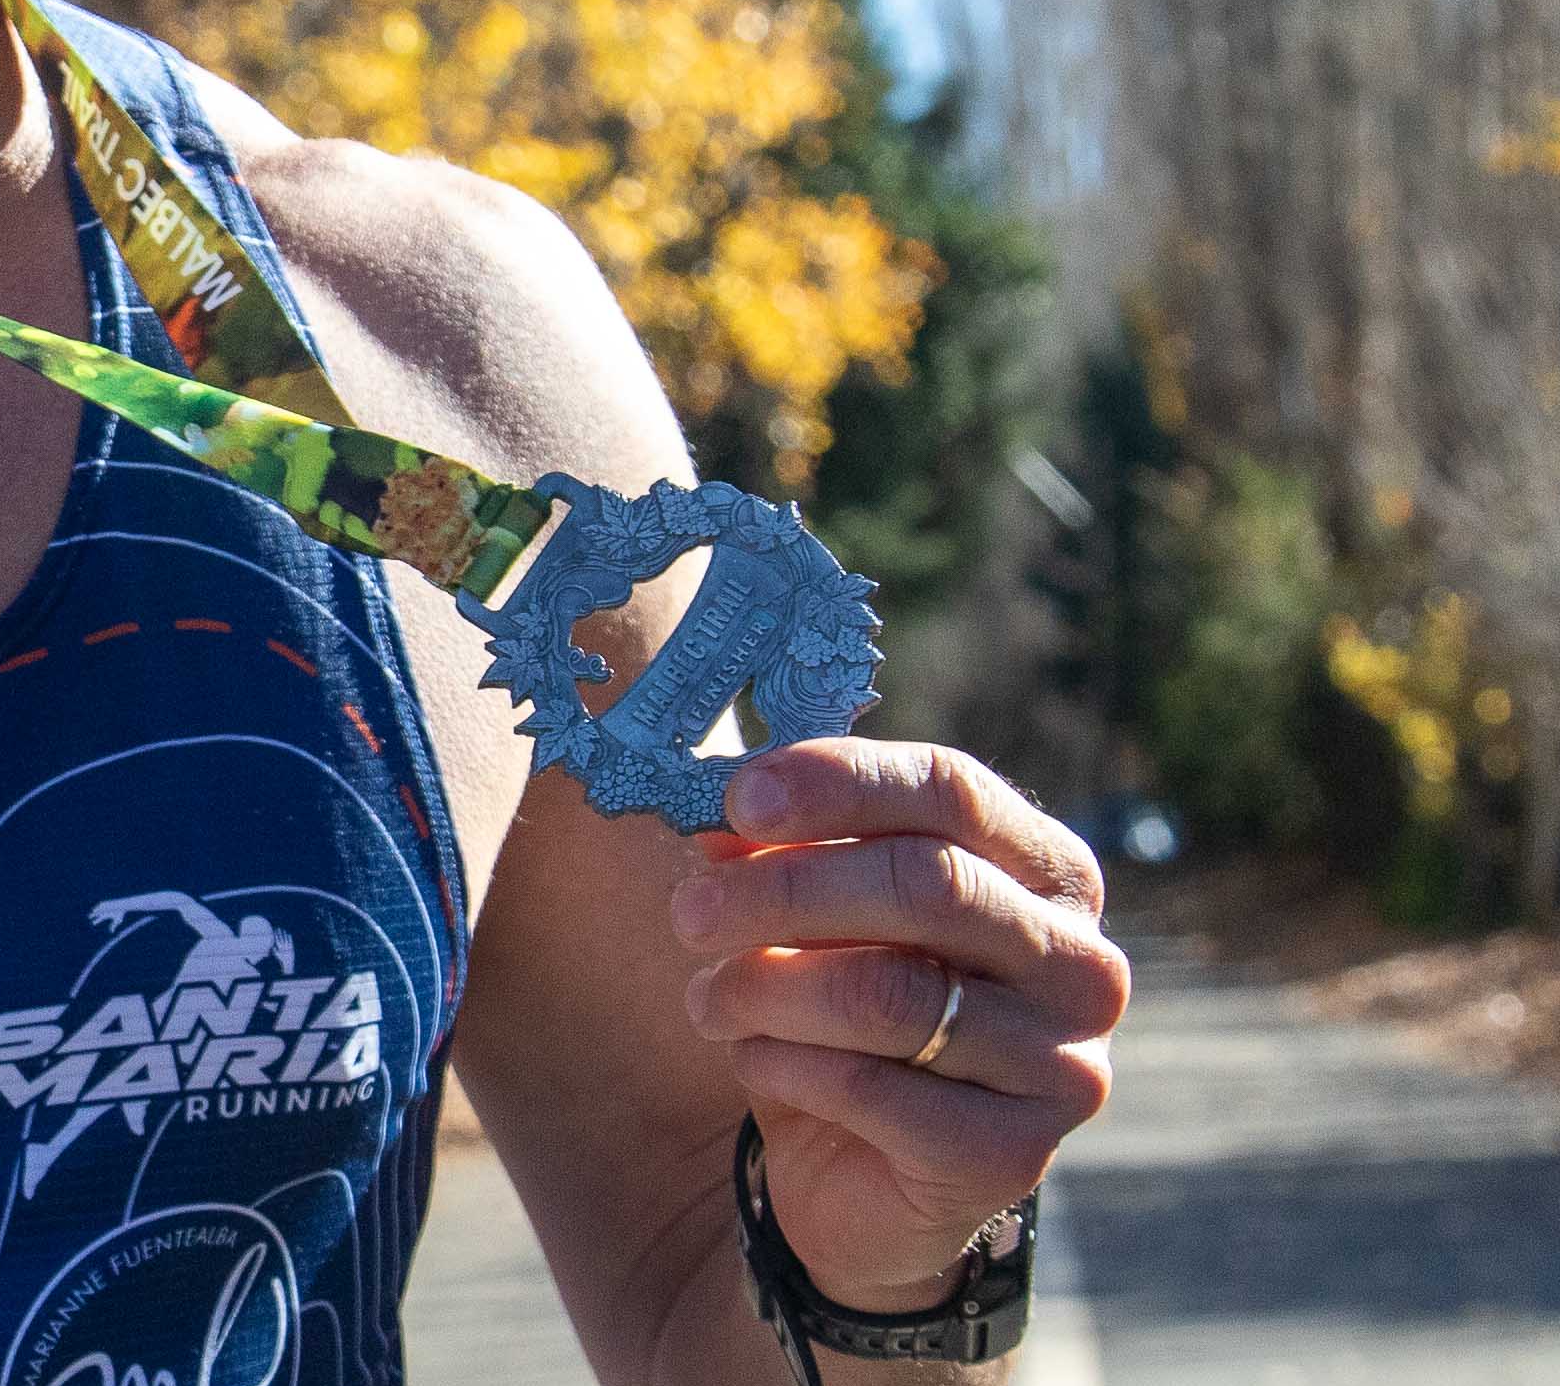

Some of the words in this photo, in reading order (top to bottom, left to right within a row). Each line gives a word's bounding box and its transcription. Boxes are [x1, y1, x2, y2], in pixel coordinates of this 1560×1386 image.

[57, 60, 122, 175] TRAIL
[114, 157, 244, 313] MALBEC
[633, 638, 706, 729] MALBEC
[694, 578, 754, 640] TRAIL
[689, 620, 770, 721] FINISHER
[185, 1077, 375, 1123] RUNNING
[109, 1226, 239, 1276] FUENTEALBA
